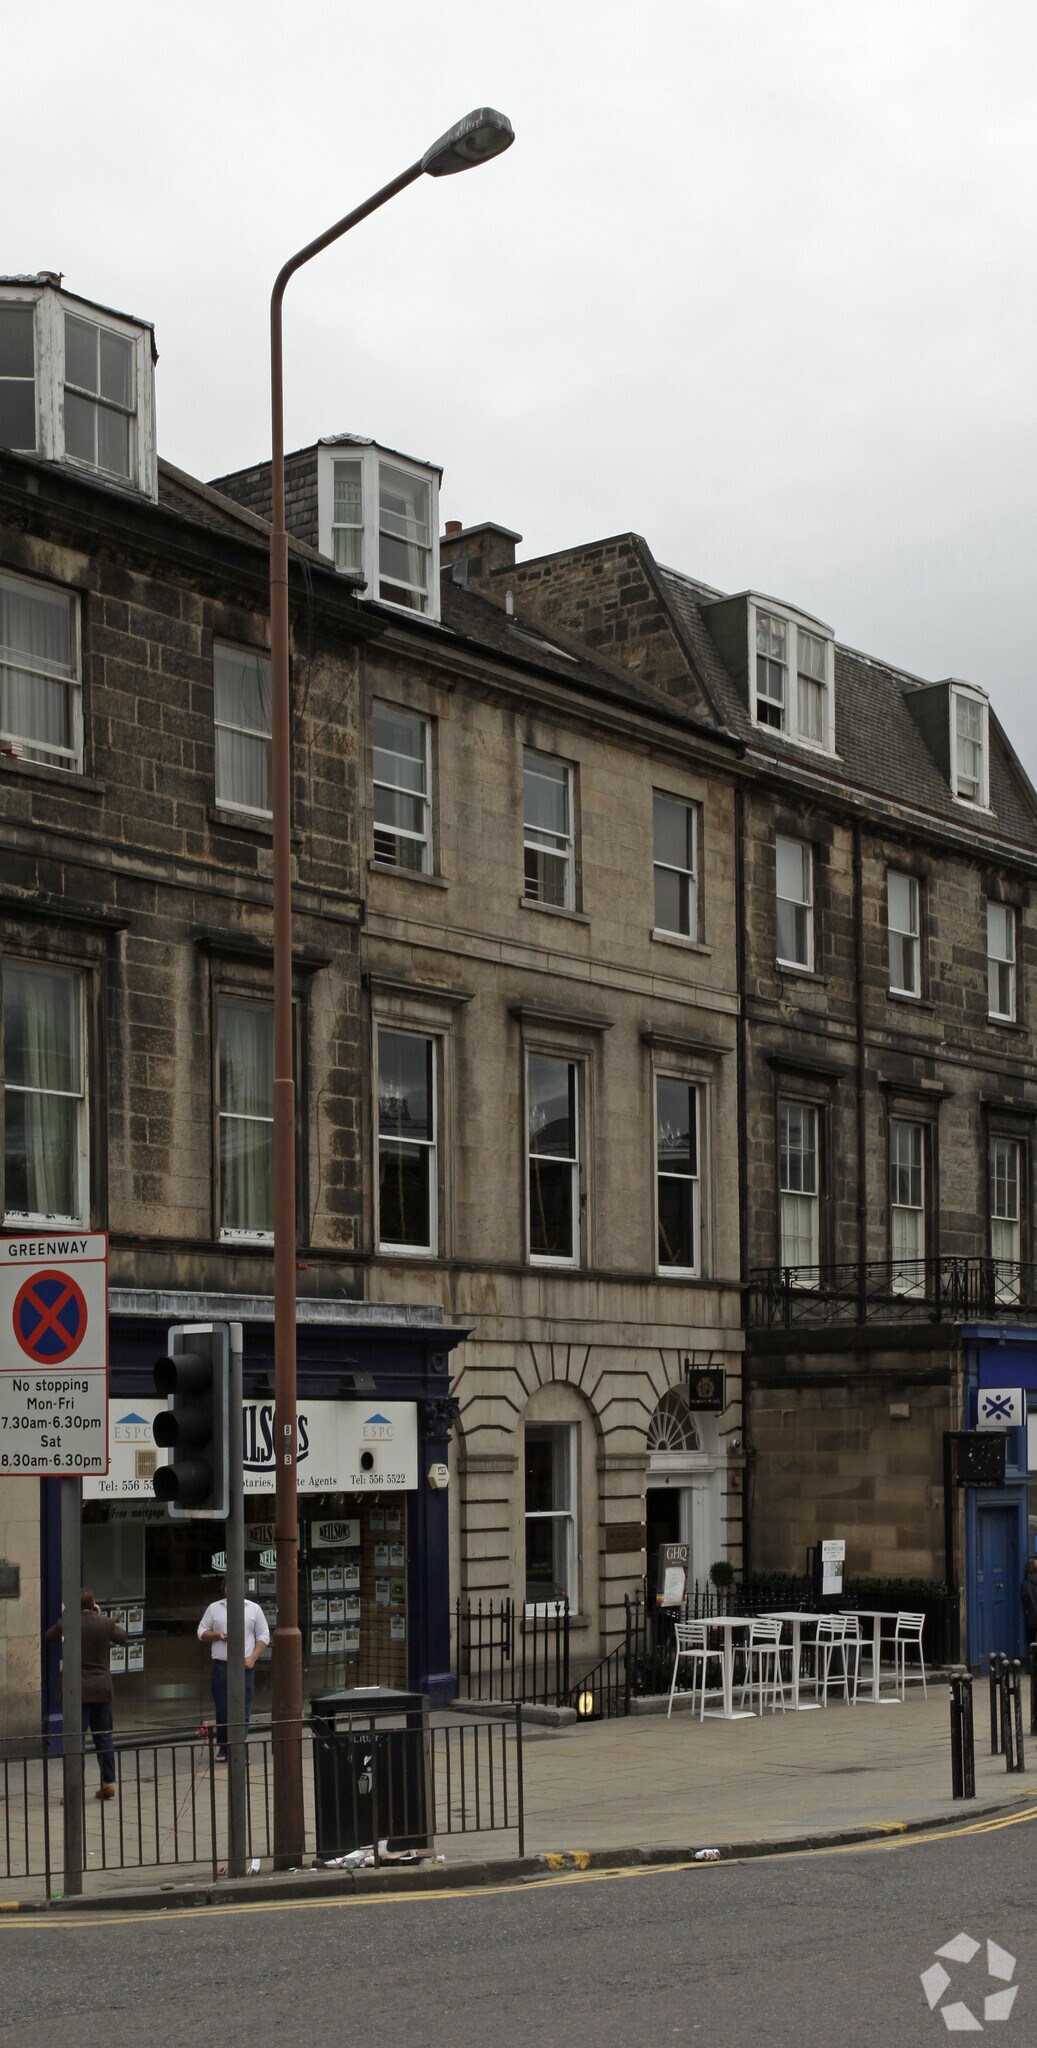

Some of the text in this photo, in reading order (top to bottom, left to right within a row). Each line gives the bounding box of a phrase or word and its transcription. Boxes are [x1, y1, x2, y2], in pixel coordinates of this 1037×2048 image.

[8, 1240, 88, 1257] GREENWAY
[12, 1378, 89, 1393] No stopping
[27, 1397, 75, 1410] Mon-Fri
[1, 1416, 102, 1430] 7.30am-6.30pm
[114, 1426, 152, 1439] ESPC
[363, 1426, 394, 1438] ESPC
[40, 1434, 62, 1448] Sat
[1, 1453, 102, 1468] 8.30am-6.30pm
[99, 1480, 118, 1491] Tel:
[121, 1480, 140, 1491] 556
[308, 1475, 338, 1488] Agents
[350, 1473, 406, 1485] Tel: 556 5522
[112, 1507, 165, 1520] Free mortgage
[319, 1522, 351, 1540] NEILSONS
[666, 1546, 688, 1562] GHQ
[353, 1734, 380, 1744] Littr
